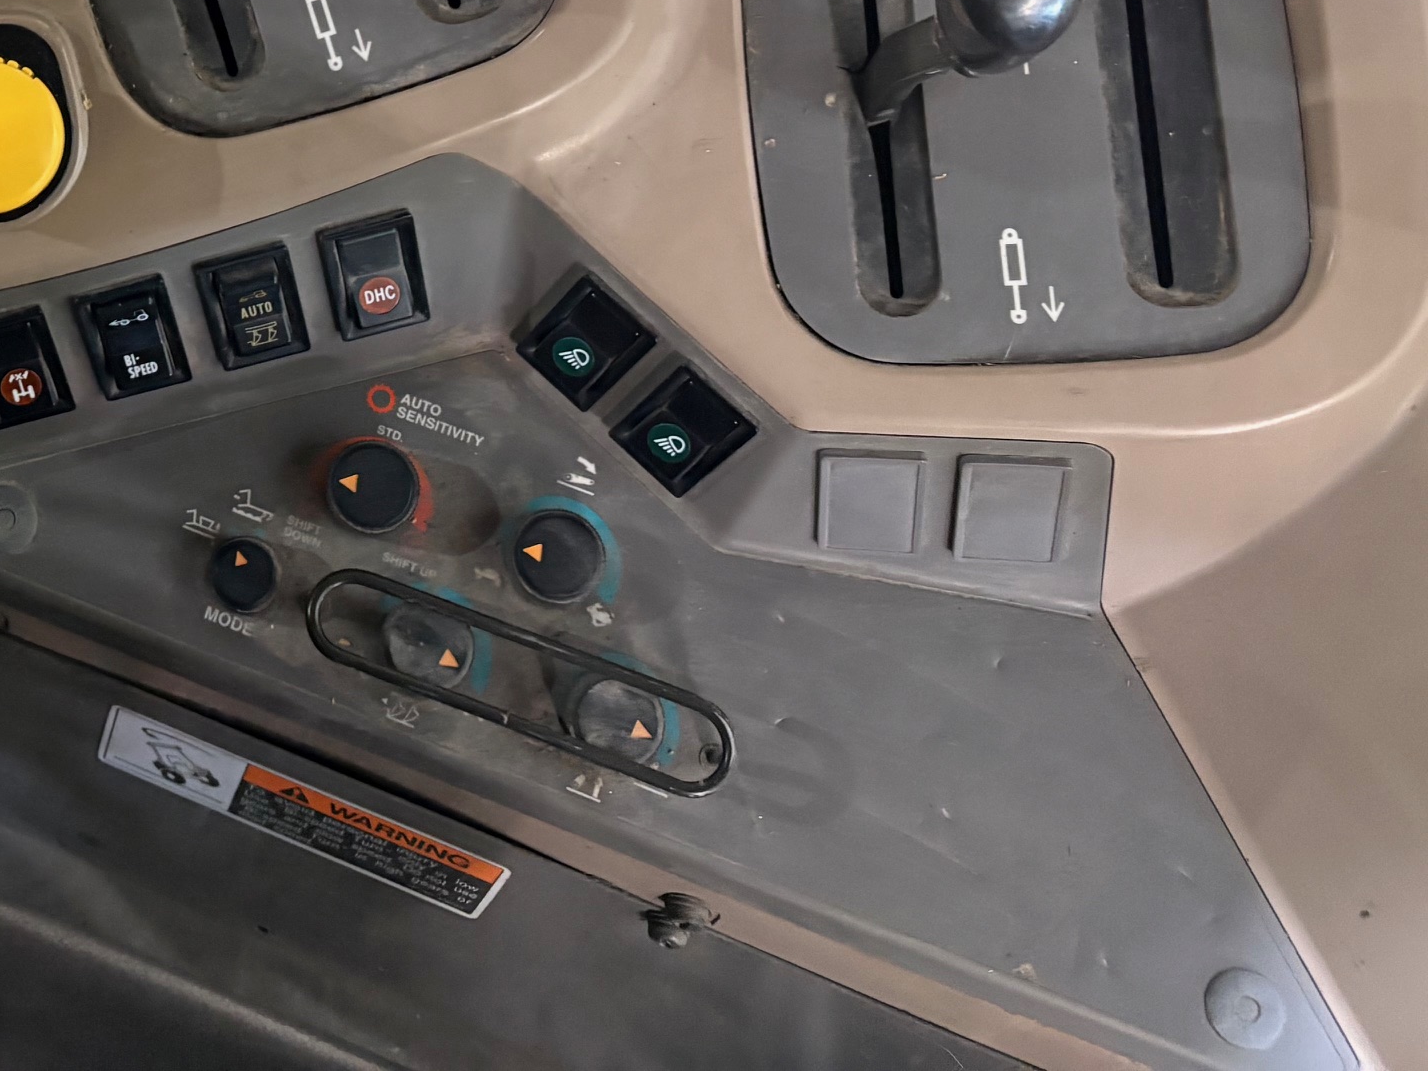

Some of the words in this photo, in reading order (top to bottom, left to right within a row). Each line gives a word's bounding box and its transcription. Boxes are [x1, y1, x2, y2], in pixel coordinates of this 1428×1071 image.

[364, 284, 395, 304] DHC
[241, 300, 272, 319] AUTO
[123, 353, 140, 367] BI-
[128, 361, 158, 379] SPEED
[400, 393, 442, 416] AUTO
[377, 424, 403, 442] STD.
[396, 406, 484, 446] SENSITIVITY
[286, 515, 323, 533] SHIFT
[284, 527, 322, 547] DOWN
[382, 551, 419, 572] SHIFT
[204, 605, 252, 637] MODE
[330, 803, 470, 869] WARNING
